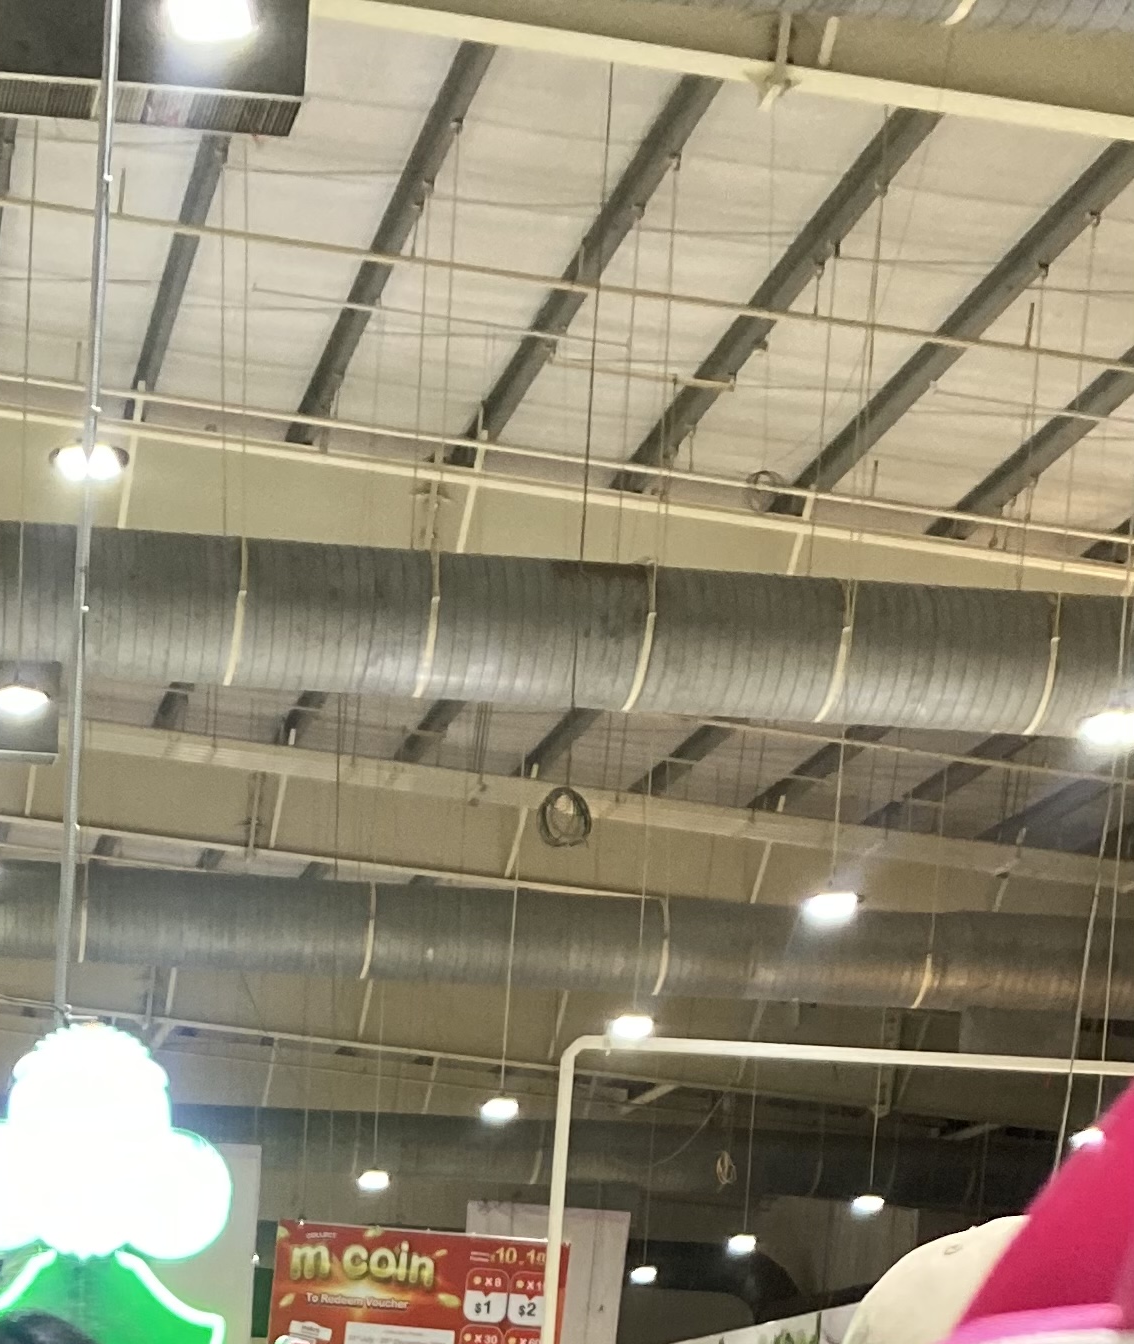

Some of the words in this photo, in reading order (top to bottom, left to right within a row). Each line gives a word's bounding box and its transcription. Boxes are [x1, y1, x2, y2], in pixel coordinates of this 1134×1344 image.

[290, 1245, 331, 1280] m
[342, 1240, 435, 1288] coin
[306, 1292, 318, 1302] To
[320, 1293, 364, 1306] Redeem
[366, 1297, 409, 1309] Voucher
[474, 1301, 491, 1315] $1
[518, 1303, 536, 1317] $2
